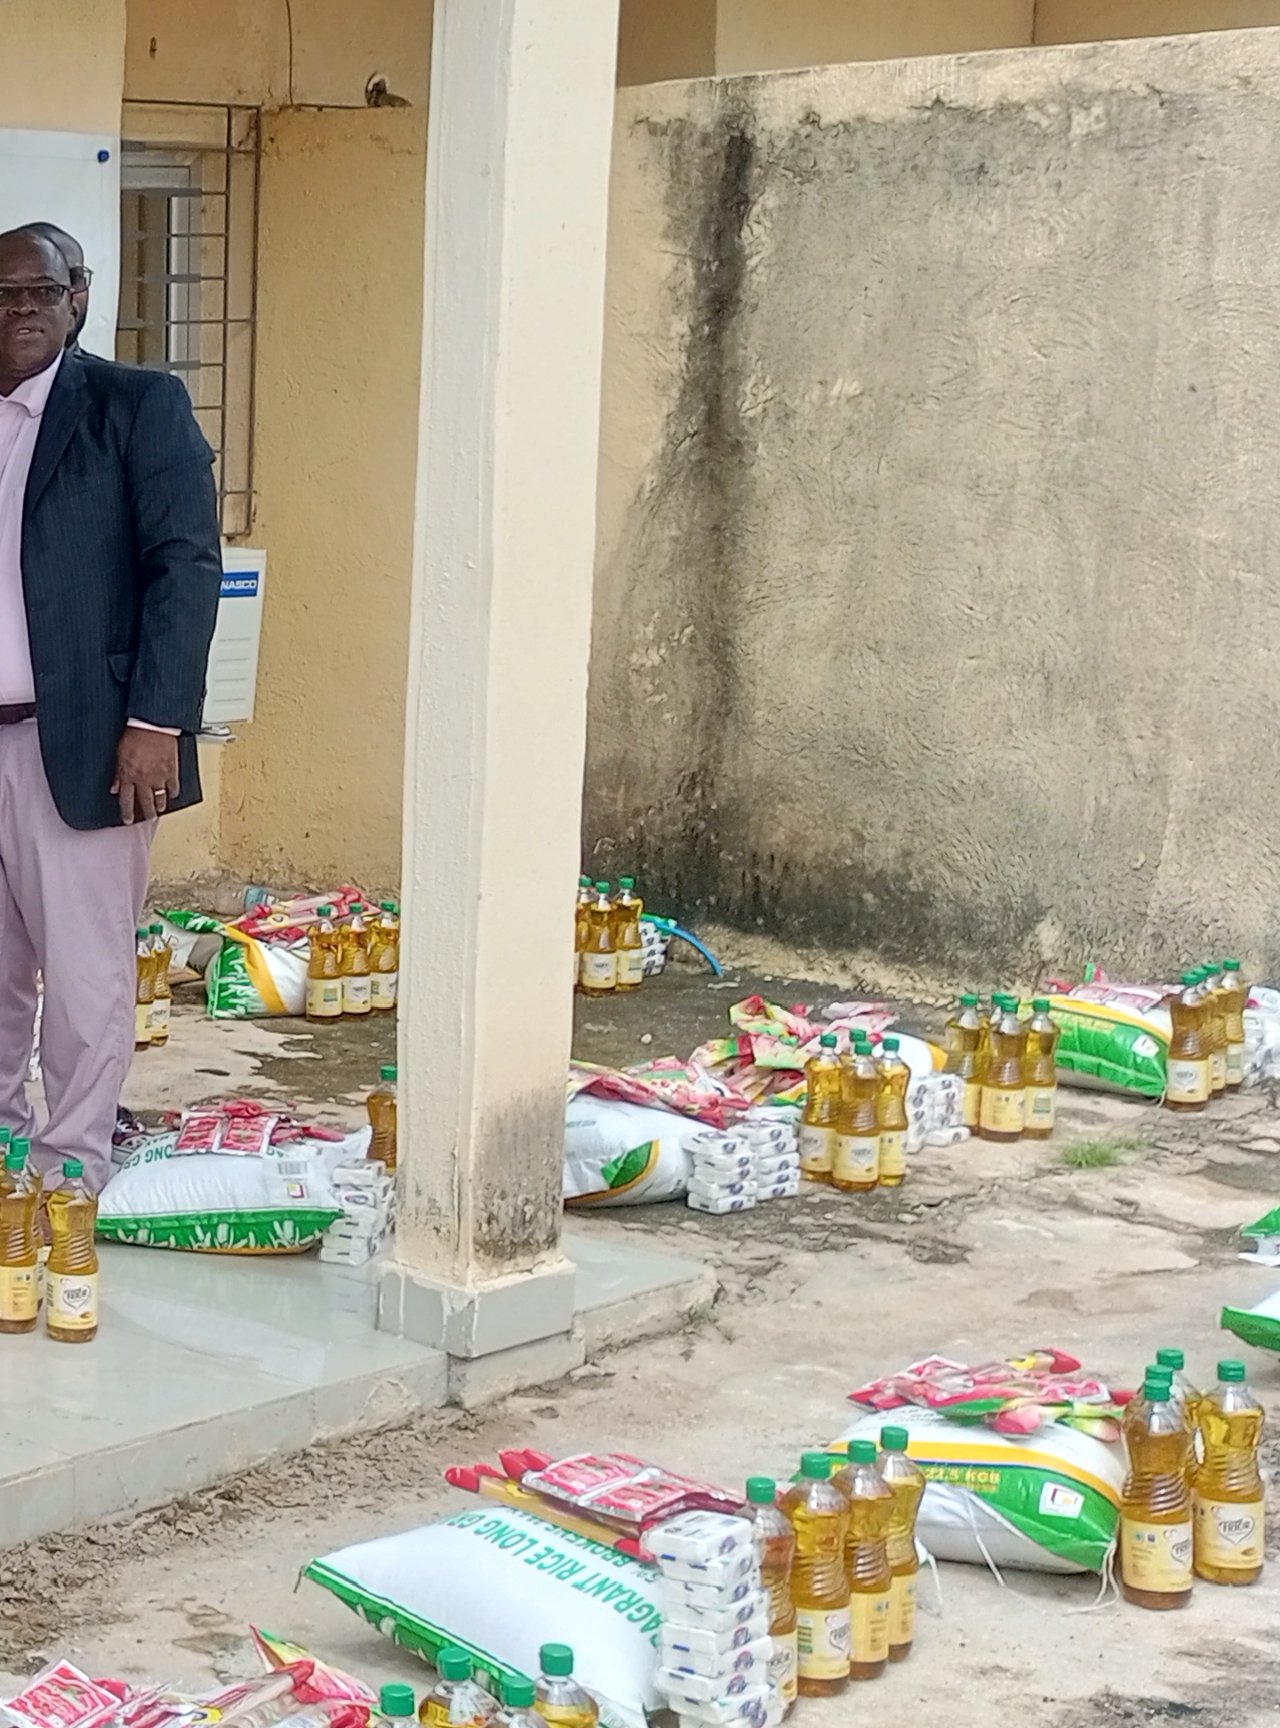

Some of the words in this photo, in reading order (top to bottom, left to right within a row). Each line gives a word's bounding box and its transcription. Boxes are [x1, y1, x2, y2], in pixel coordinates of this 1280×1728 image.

[221, 579, 258, 591] NASCO
[143, 1143, 174, 1164] ONG
[473, 1517, 540, 1557] LONG
[523, 1545, 588, 1581] RICE
